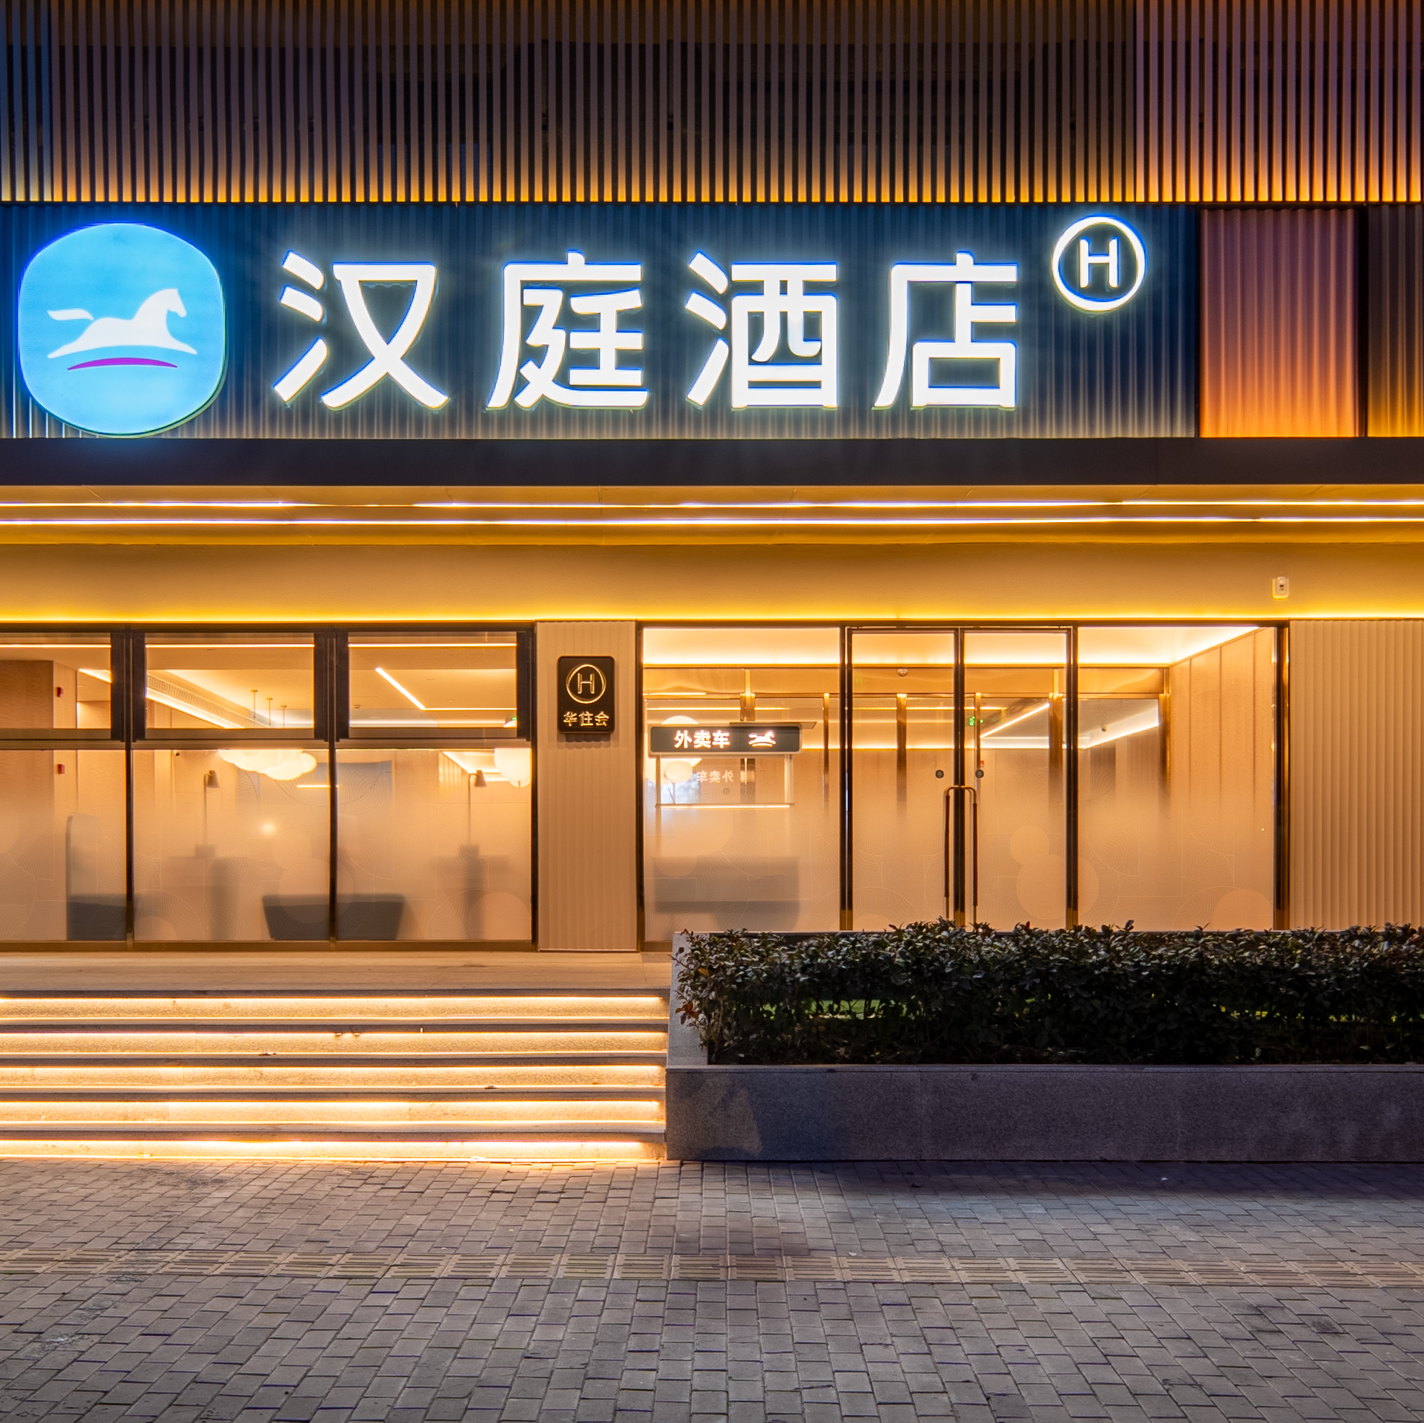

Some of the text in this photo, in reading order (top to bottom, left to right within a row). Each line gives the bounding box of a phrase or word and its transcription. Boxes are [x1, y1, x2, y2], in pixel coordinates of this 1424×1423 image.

[273, 250, 1018, 412] 汉庭酒店
[563, 711, 610, 727] 华住会
[674, 730, 730, 749] 外卖车
